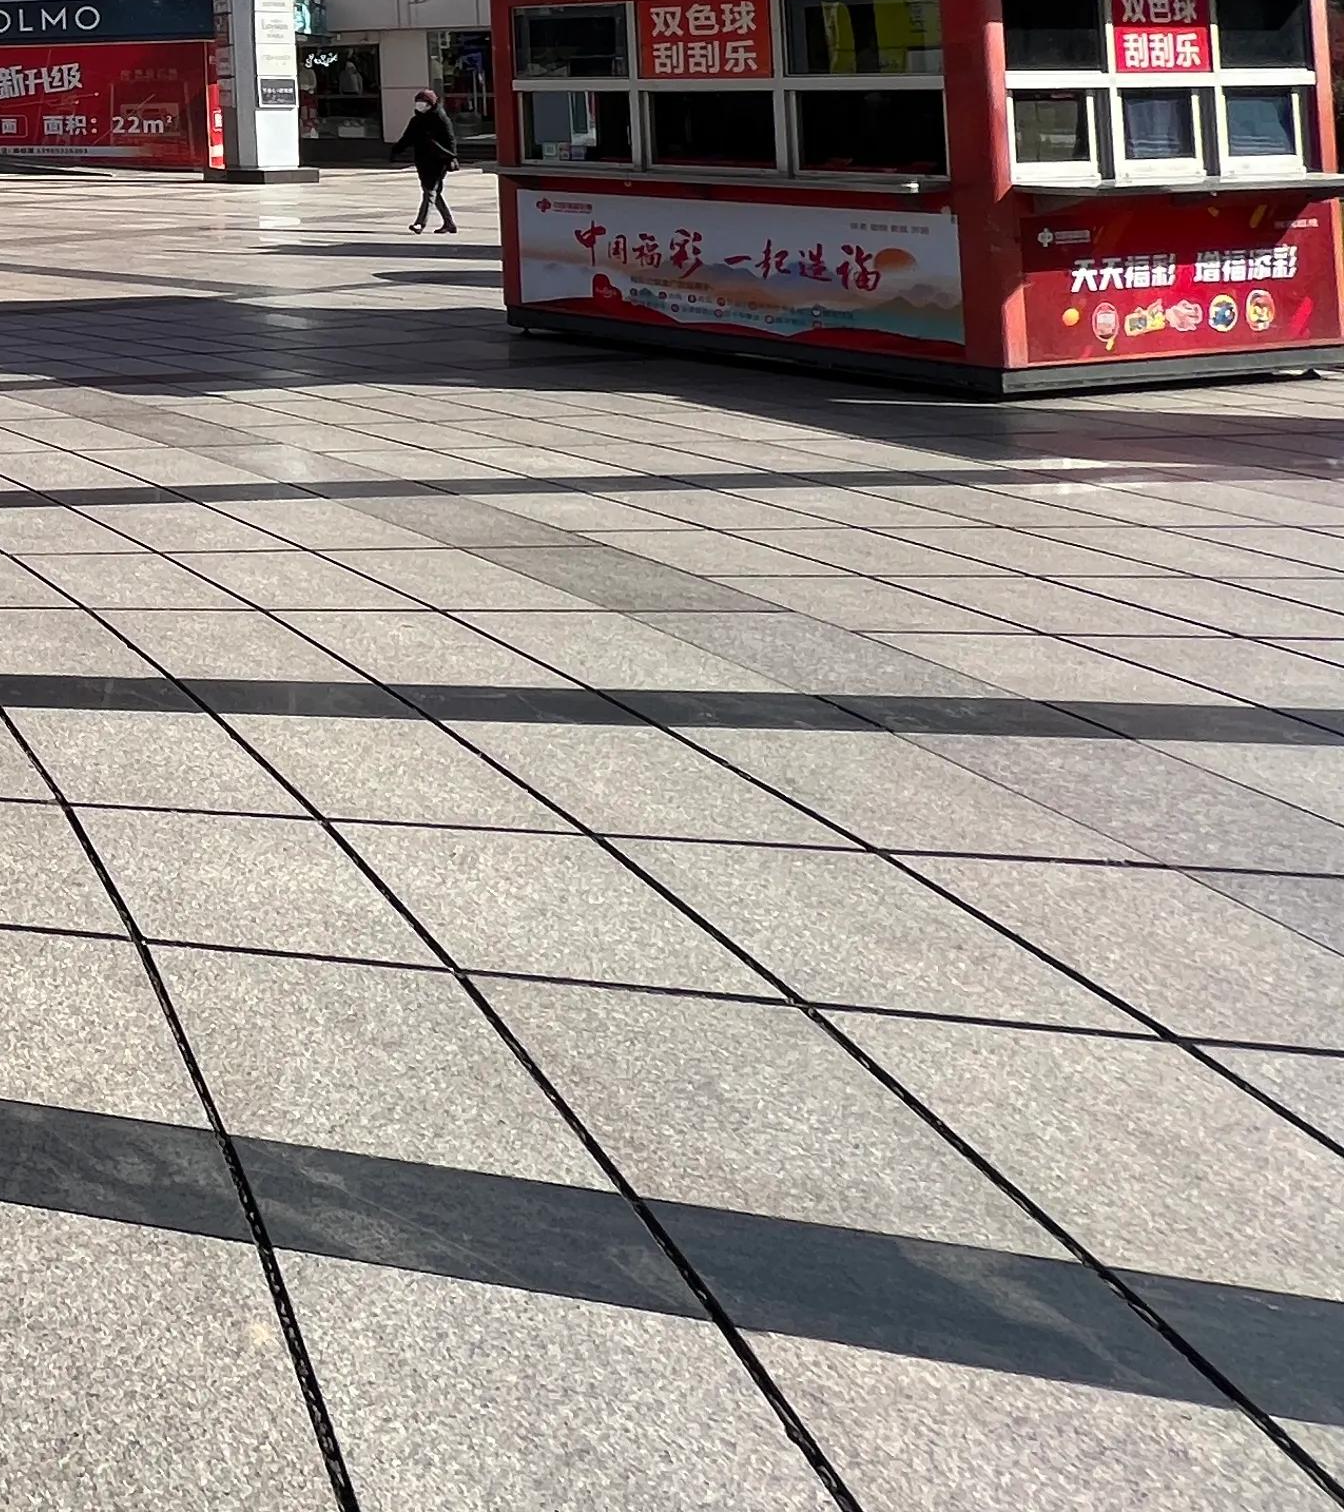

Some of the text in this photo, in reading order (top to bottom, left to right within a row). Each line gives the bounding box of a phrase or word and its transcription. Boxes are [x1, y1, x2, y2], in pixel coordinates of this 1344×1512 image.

[650, 1, 756, 37] 双色球
[652, 40, 758, 74] 刮刮乐
[1122, 32, 1202, 68] 刮刮乐
[574, 219, 704, 279] 中国福彩
[1071, 252, 1176, 293] 天天福彩
